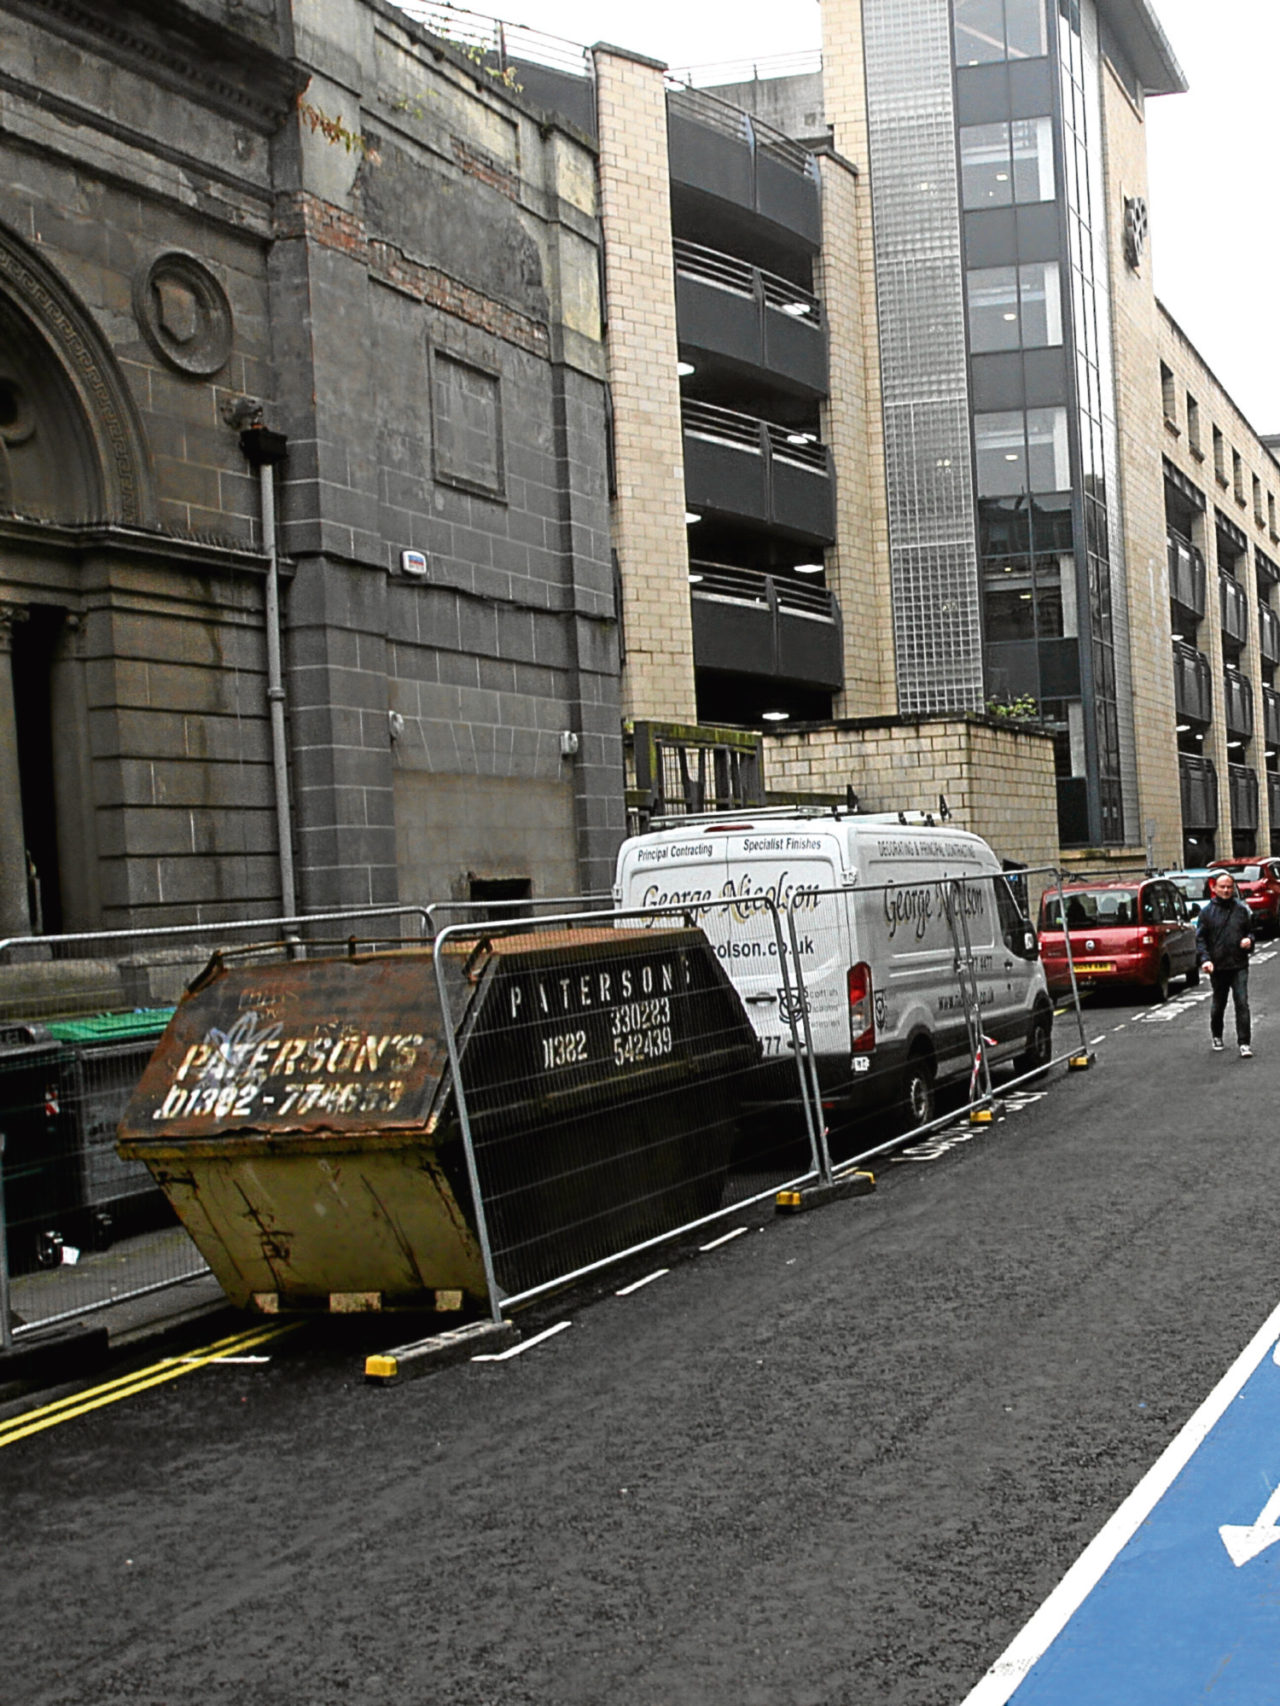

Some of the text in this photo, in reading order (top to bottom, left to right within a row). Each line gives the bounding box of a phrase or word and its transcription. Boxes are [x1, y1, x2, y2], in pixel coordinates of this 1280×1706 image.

[637, 837, 822, 862] Principal Contracting Specialist Finishes
[884, 879, 933, 940] George
[610, 997, 671, 1036] 330283
[176, 1033, 425, 1082] PATERSON'S
[613, 1026, 673, 1066] 542439
